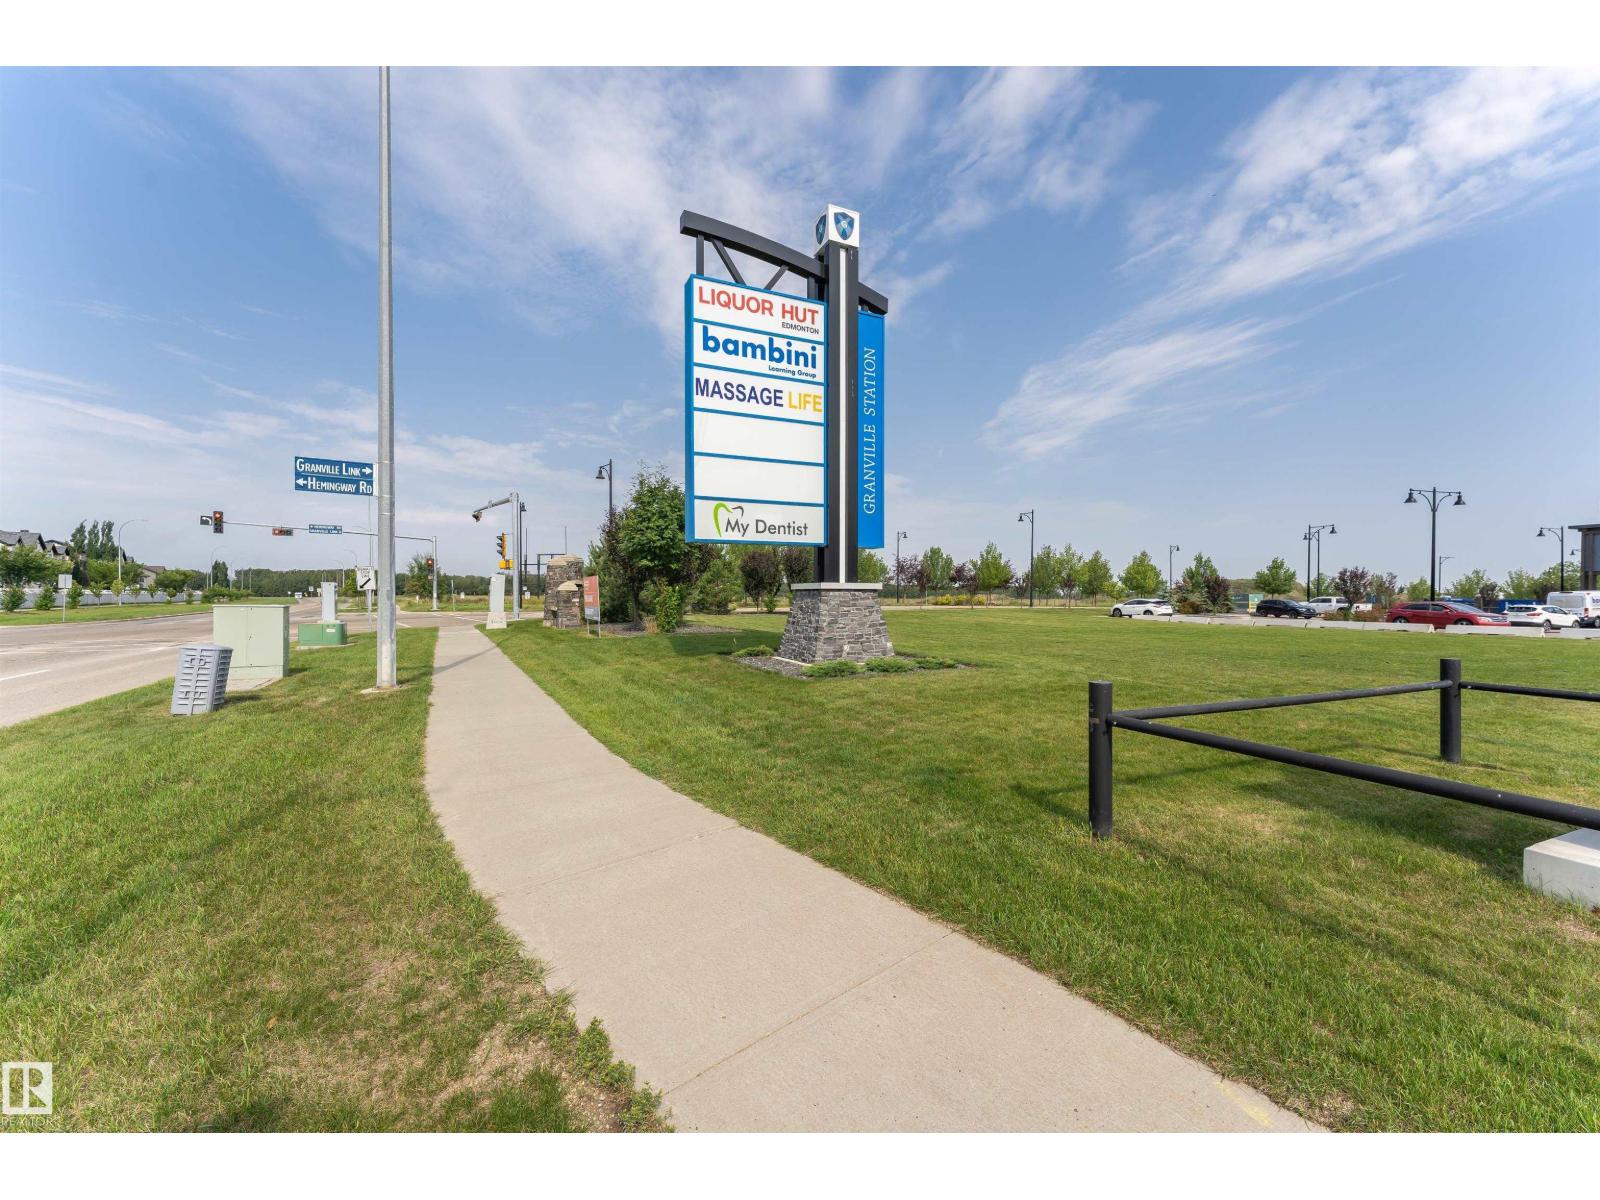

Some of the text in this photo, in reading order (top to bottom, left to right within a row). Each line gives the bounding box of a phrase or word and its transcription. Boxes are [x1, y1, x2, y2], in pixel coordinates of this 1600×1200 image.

[698, 286, 819, 325] LIQUOR HUT
[781, 321, 820, 335] EDMONTON
[702, 324, 817, 369] bambini
[768, 365, 817, 379] Learning Group
[695, 377, 823, 412] MASSAGE LIFE
[863, 346, 876, 514] GRANVILLE STATION
[296, 458, 361, 477] GRANVILLE LINK
[307, 476, 357, 493] HEMINGWAY
[725, 517, 809, 537] My Dentist
